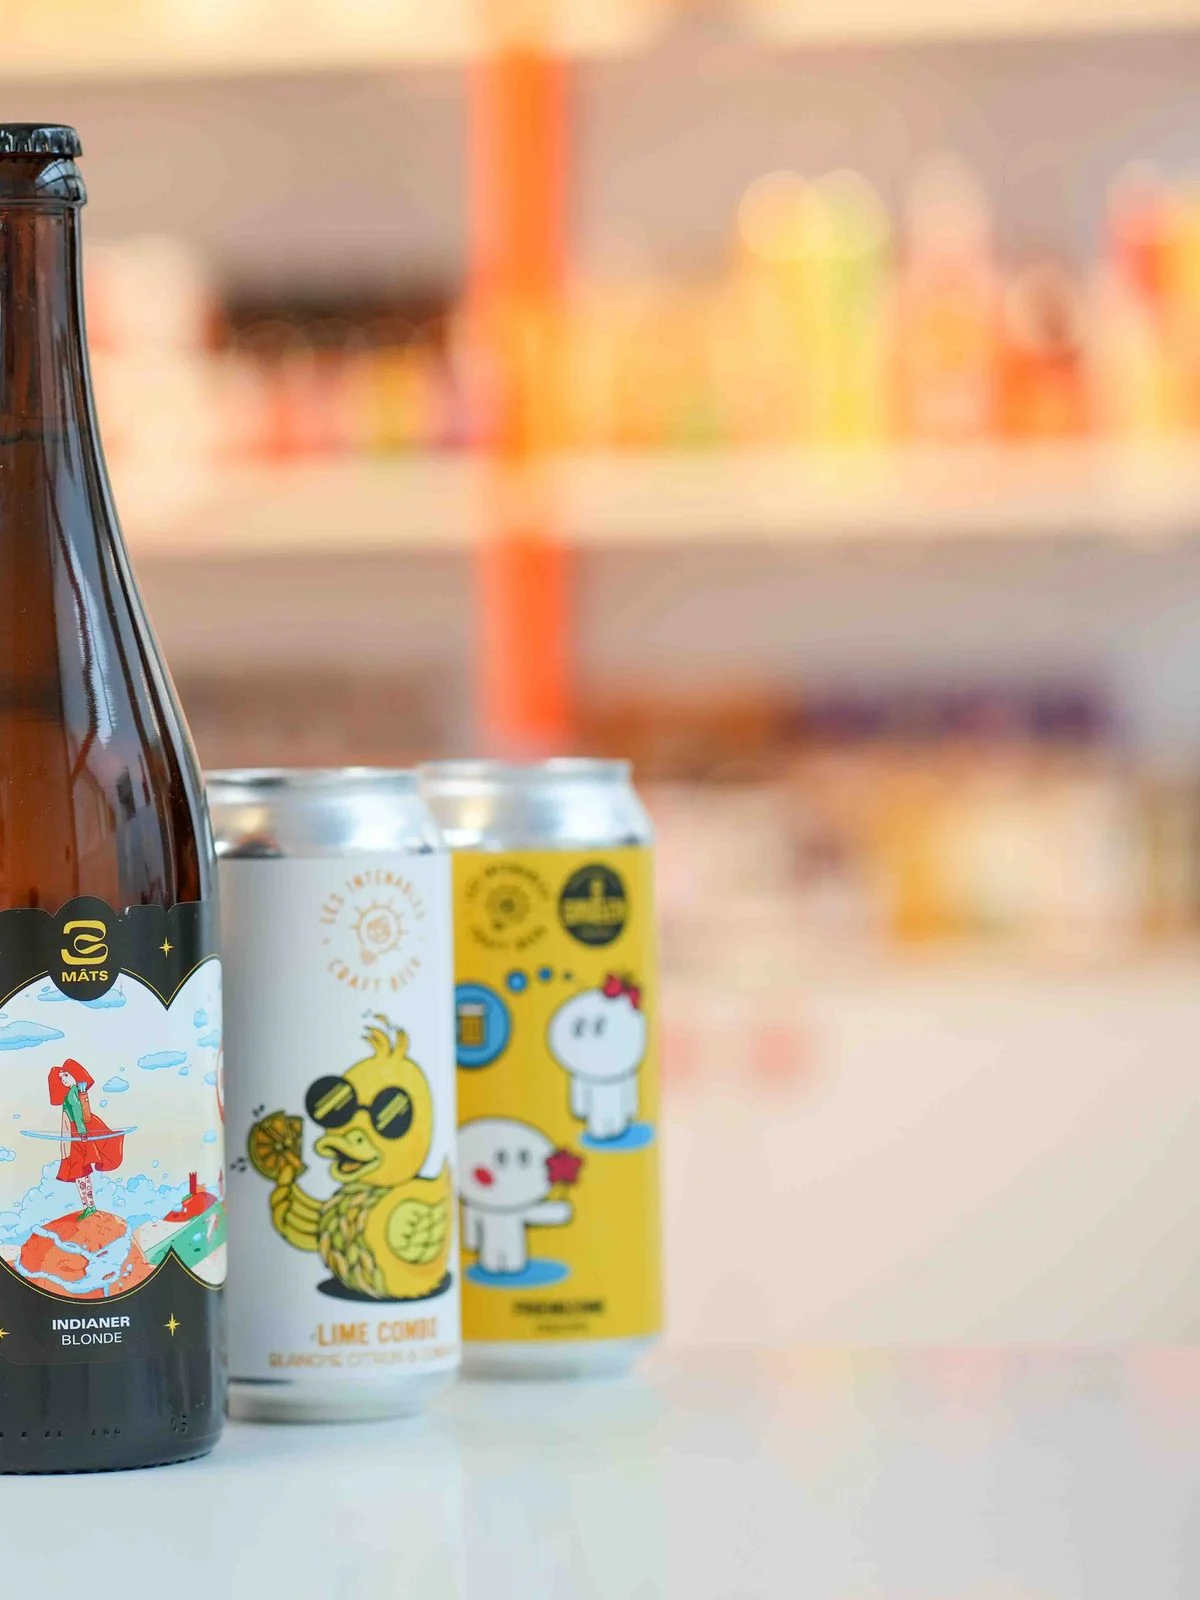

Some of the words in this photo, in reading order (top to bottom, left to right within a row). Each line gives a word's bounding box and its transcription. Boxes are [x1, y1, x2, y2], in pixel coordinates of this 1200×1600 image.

[61, 968, 109, 982] MÂTS
[52, 1316, 131, 1330] INDIANER
[61, 1332, 123, 1346] BLONDE
[317, 1322, 369, 1347] LIME
